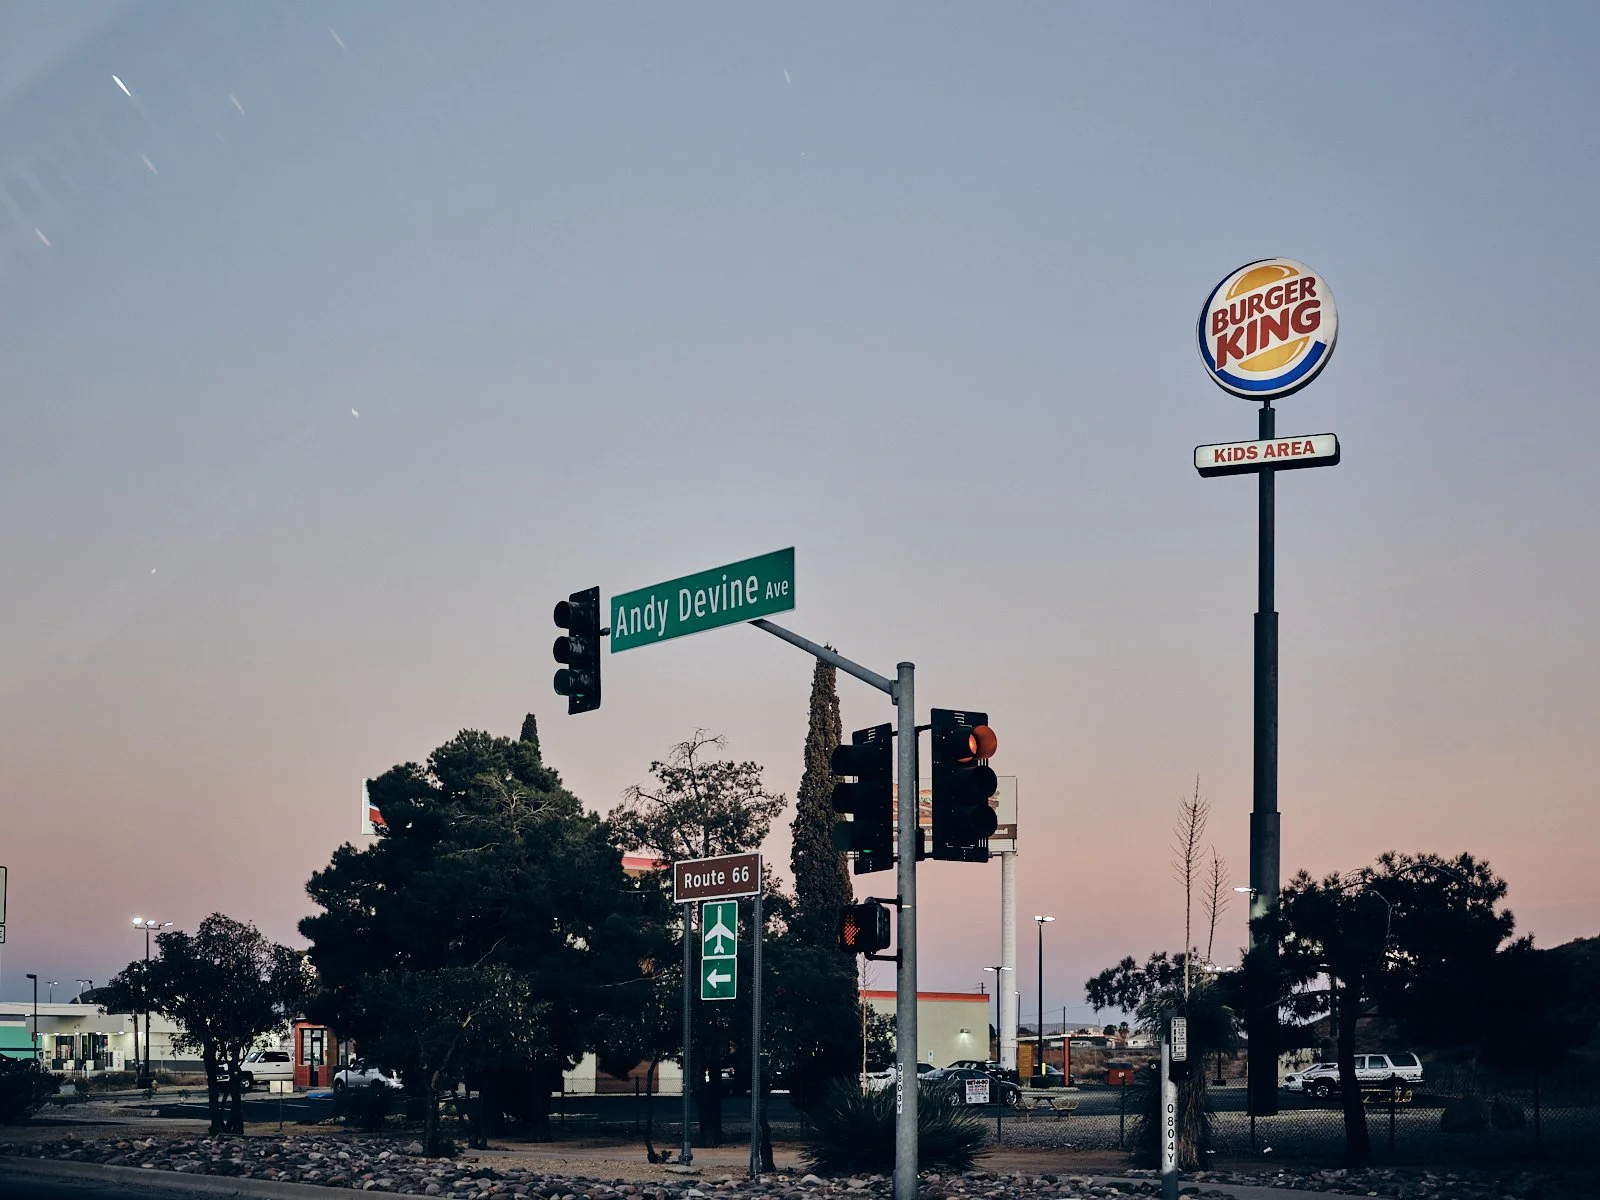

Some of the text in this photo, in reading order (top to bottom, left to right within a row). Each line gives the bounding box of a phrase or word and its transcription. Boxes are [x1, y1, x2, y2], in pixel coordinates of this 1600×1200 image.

[1212, 276, 1317, 336] BURGER
[1216, 300, 1321, 370] KING
[1263, 441, 1315, 458] AREA
[615, 574, 789, 638] Andy Devine Ave
[684, 866, 749, 888] Route 66
